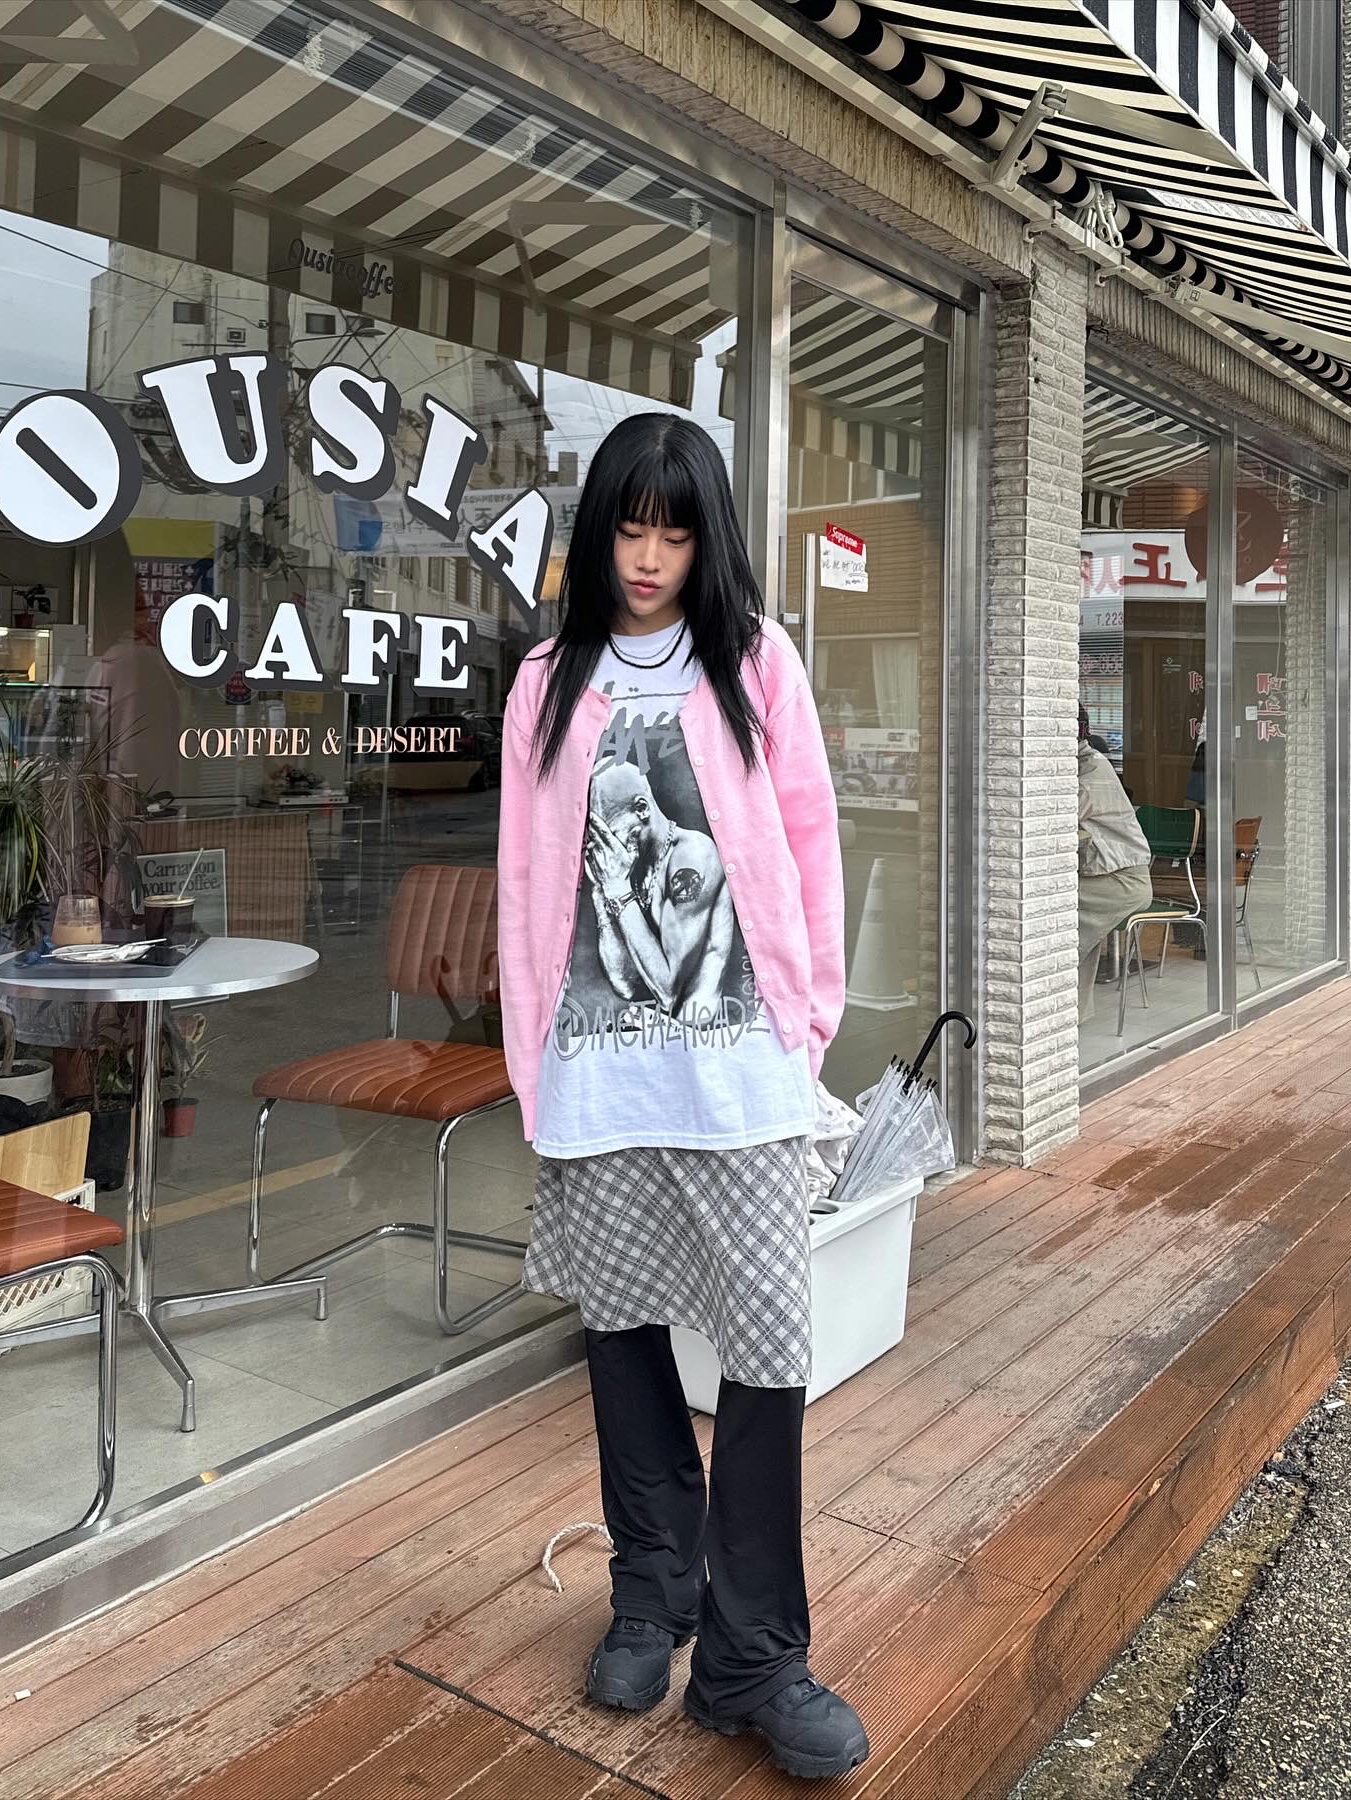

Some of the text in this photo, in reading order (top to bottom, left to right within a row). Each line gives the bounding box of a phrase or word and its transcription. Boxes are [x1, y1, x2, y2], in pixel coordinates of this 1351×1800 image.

[0, 354, 552, 612] OUSIA
[831, 526, 859, 548] Supreme
[159, 592, 473, 692] CAFE
[179, 726, 462, 760] COFFEE & DESERT
[144, 859, 215, 878] Carnaton
